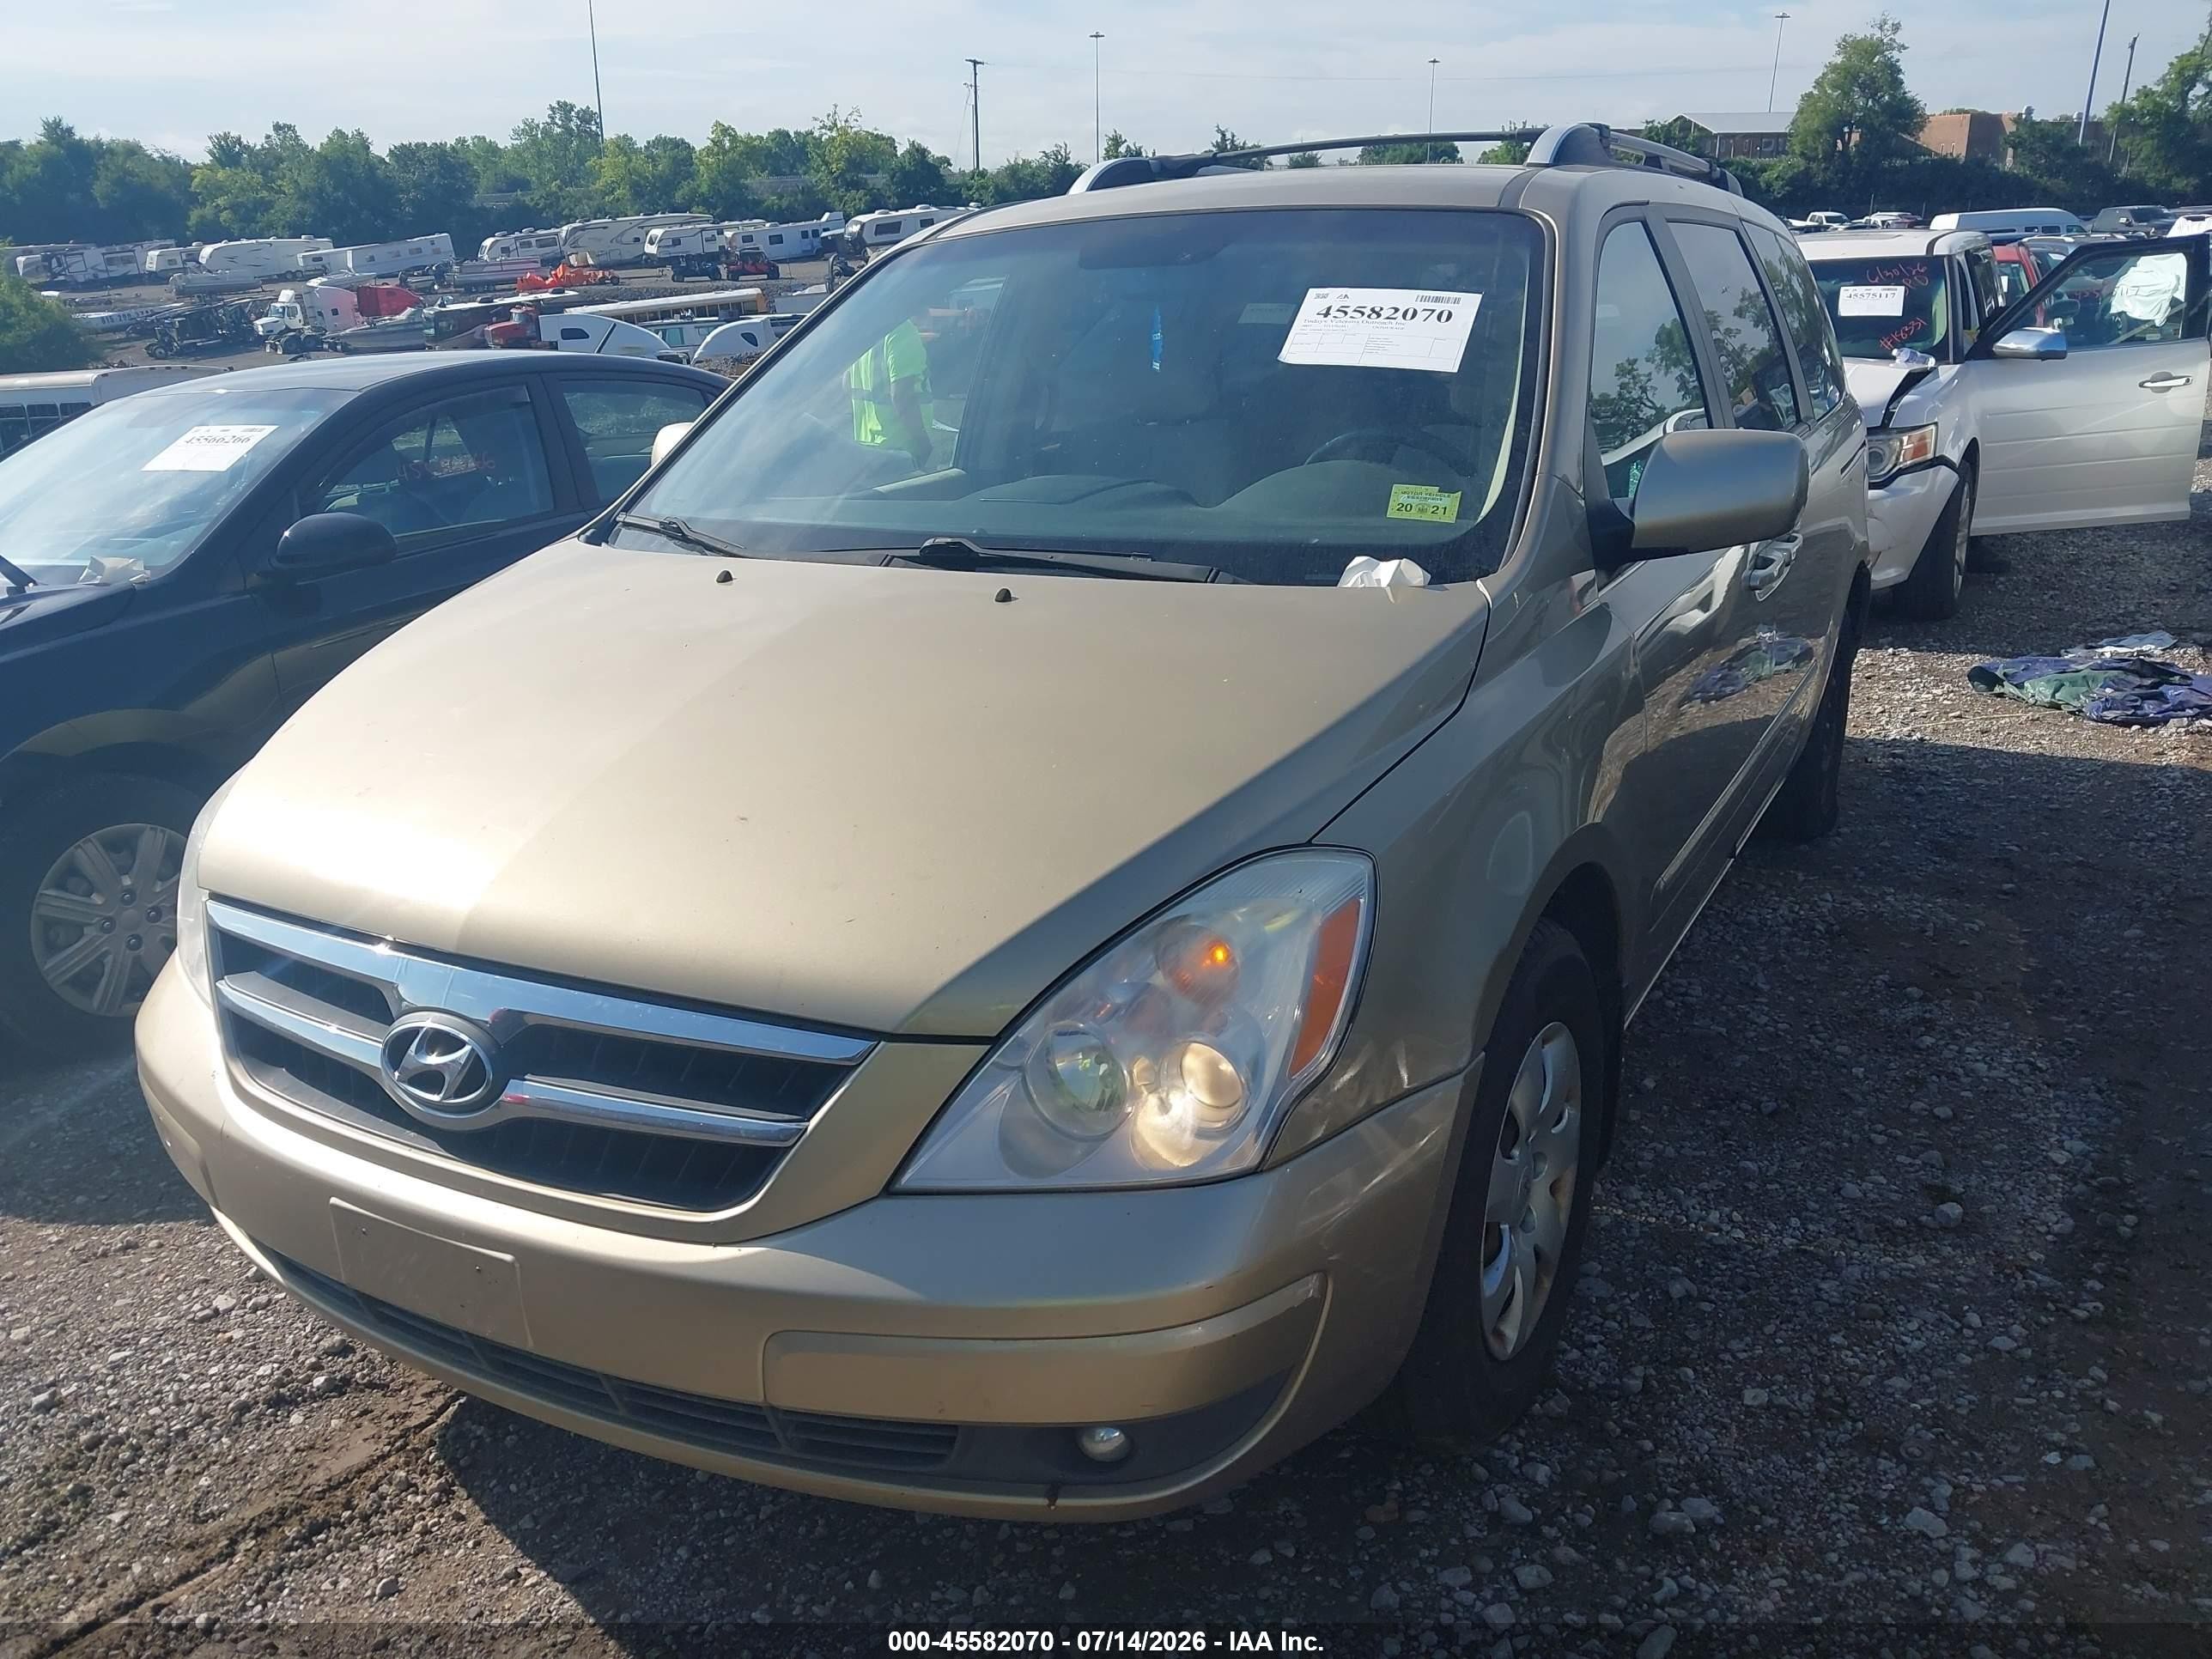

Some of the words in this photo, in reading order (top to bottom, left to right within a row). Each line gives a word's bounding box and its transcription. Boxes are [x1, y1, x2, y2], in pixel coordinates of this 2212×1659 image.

[1316, 304, 1454, 324] 45582070
[1396, 502, 1413, 513] 20
[1431, 505, 1448, 515] 21
